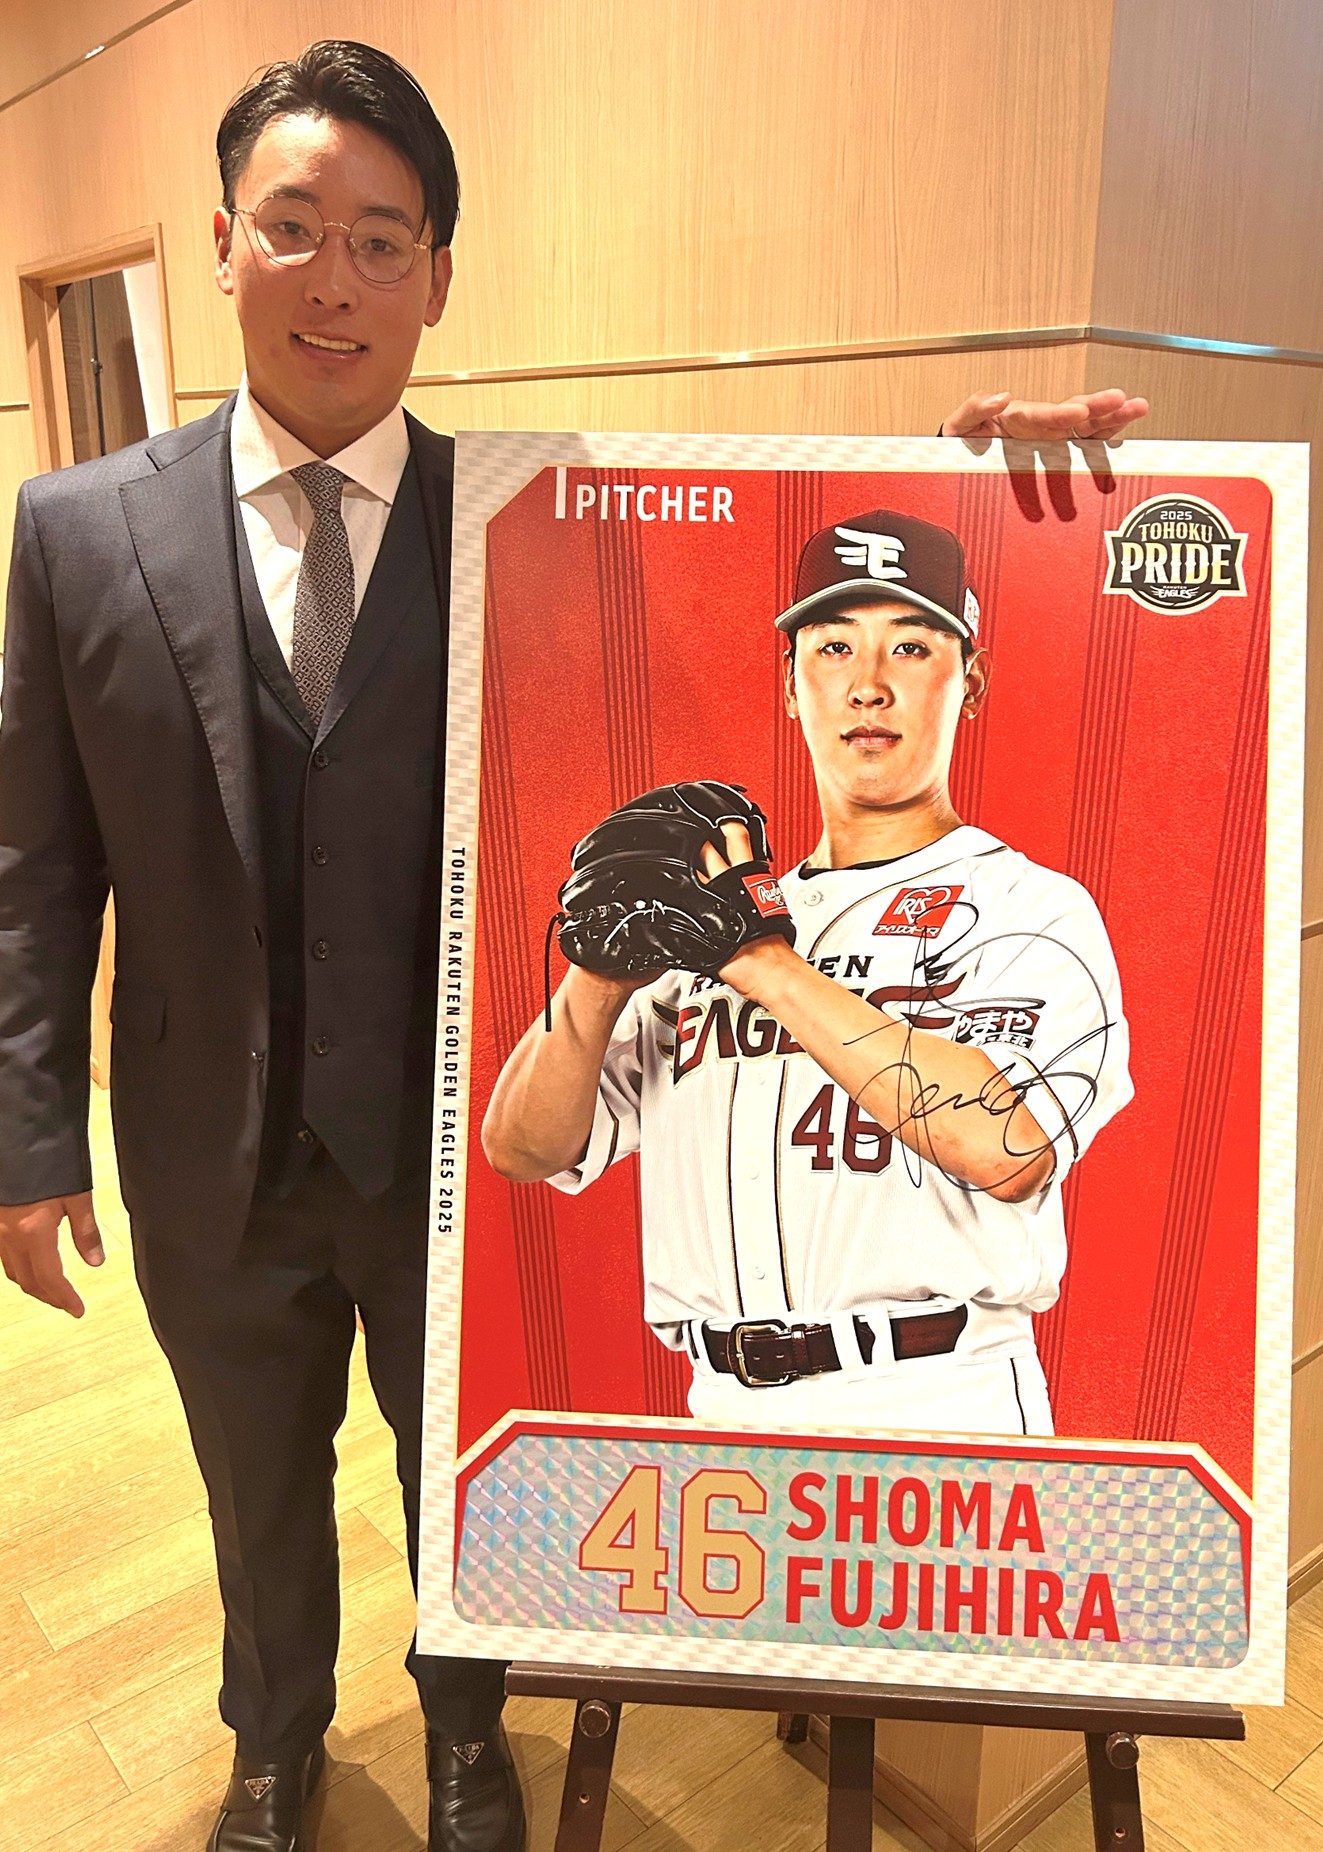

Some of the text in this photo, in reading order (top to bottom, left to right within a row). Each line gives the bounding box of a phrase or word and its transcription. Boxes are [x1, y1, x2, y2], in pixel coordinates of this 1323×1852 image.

[575, 484, 736, 523] PITCHER
[1138, 521, 1213, 544] TOHOKU
[1159, 510, 1193, 521] 2025
[1119, 541, 1232, 585] PRIDE
[437, 847, 466, 1233] TOHOKU RAKUTEN GOLDEN EAGLES 2025
[791, 1083, 894, 1174] 46
[579, 1464, 767, 1620] 46
[785, 1471, 1046, 1554] SHOMA
[785, 1556, 1122, 1643] FUJIHIRA
